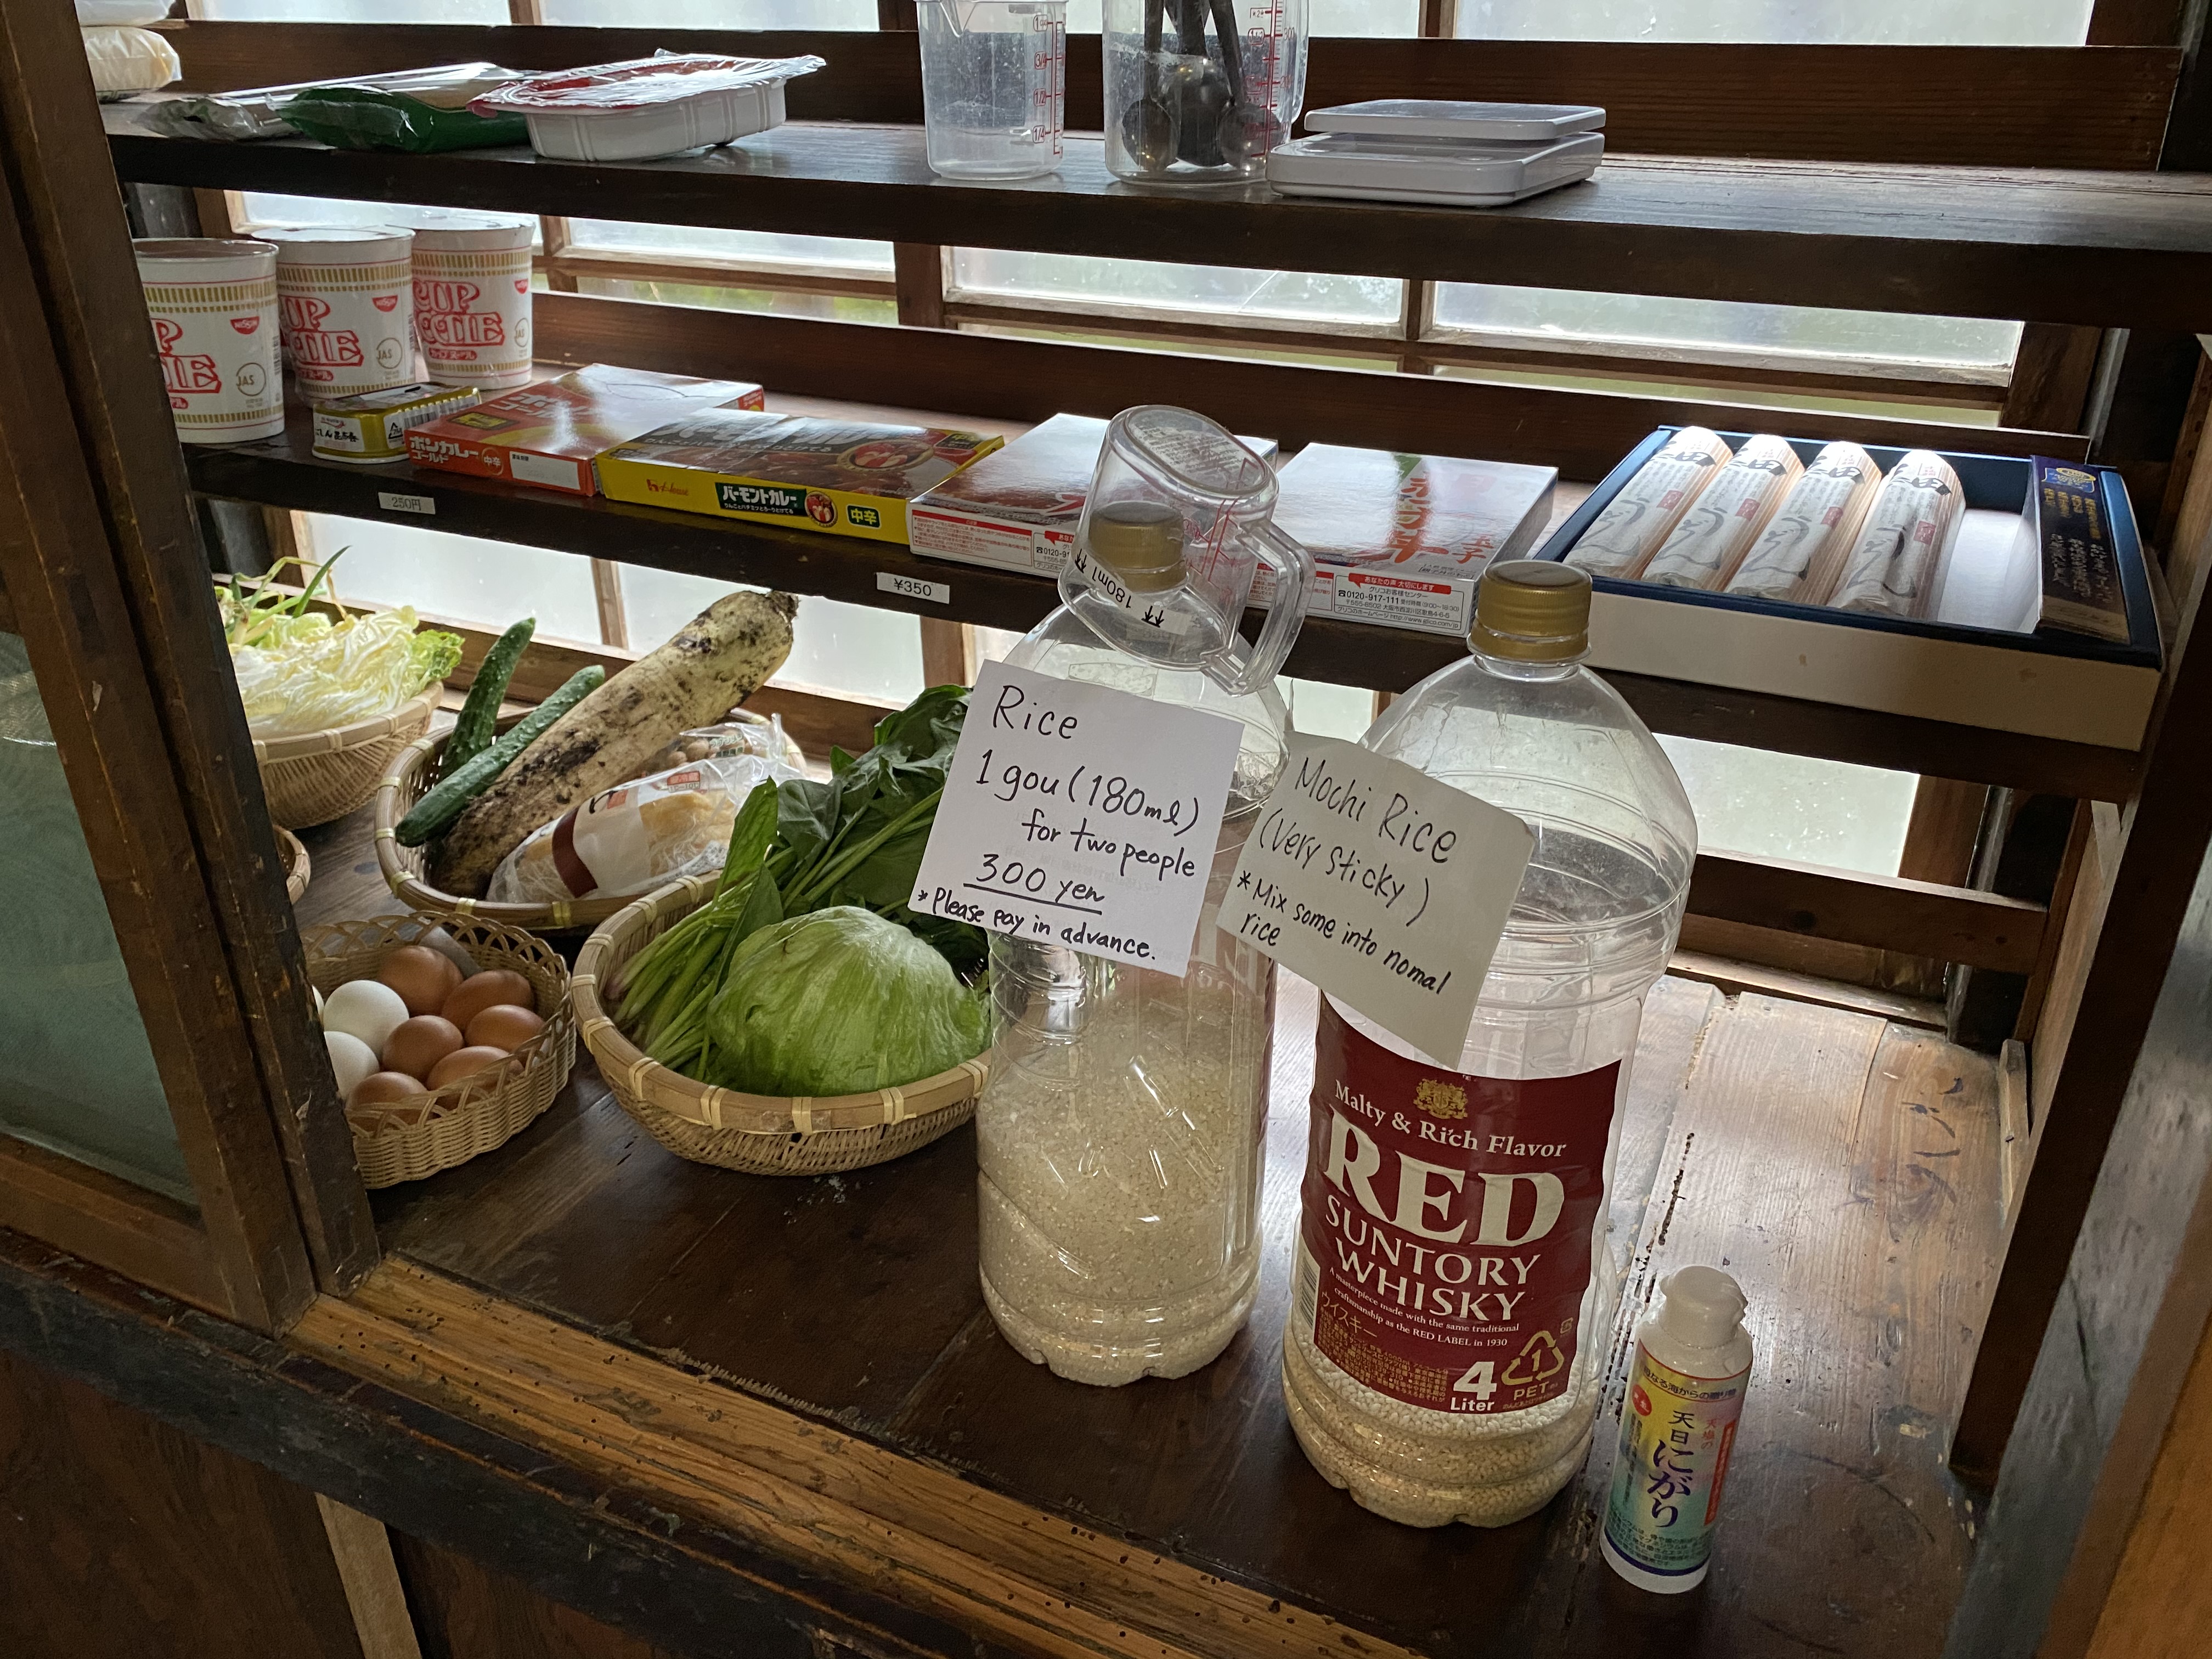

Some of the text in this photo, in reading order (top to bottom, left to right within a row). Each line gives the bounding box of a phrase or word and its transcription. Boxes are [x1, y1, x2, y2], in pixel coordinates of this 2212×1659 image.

[1036, 54, 1047, 67] 3/4
[1035, 91, 1046, 104] 1/2
[1034, 128, 1045, 140] 1/4
[280, 295, 331, 329] UP
[377, 349, 392, 360] JAS
[236, 375, 255, 386] JAS
[409, 437, 478, 458] ボンカレー
[413, 449, 449, 464] ゴールド
[483, 455, 501, 467] 中辛
[391, 496, 421, 511] 250円
[723, 485, 797, 506] バーモントカレー
[850, 508, 877, 526] 中辛
[894, 578, 932, 597] ¥350
[1364, 576, 1435, 591] あなたの声 大切にします
[1369, 586, 1428, 598] グリコお客様センター
[1346, 590, 1398, 605] 0120-917-111
[1338, 606, 1389, 618] グリコのホームページ
[992, 684, 1077, 740] Rice
[1294, 757, 1457, 864] Mochi Rice
[1022, 808, 1195, 881] for two people
[1259, 807, 1321, 870] (Very
[976, 853, 1105, 904] 300 yen
[993, 906, 1024, 935] pay
[1033, 915, 1051, 935] in
[1061, 922, 1155, 960] advance.
[1239, 912, 1281, 946] rice
[1293, 902, 1336, 939] some
[1341, 922, 1378, 957] into
[1383, 949, 1452, 996] nomal
[1334, 1079, 1567, 1158] Malty & Rich Flavor
[1323, 1103, 1565, 1248] RED
[1325, 1194, 1542, 1286] SUNTORY
[1335, 1237, 1526, 1322] WHISKY
[1329, 1267, 1519, 1333] A masterpiece made with the same traditional
[1321, 1291, 1378, 1338] ウイスキー
[1334, 1288, 1508, 1347] craftsmanship as the RED LABEL in 1930
[1453, 1361, 1497, 1401] 4
[1513, 1381, 1550, 1401] PET
[1450, 1397, 1496, 1413] Liter
[1646, 1410, 1696, 1528] 天日にがり
